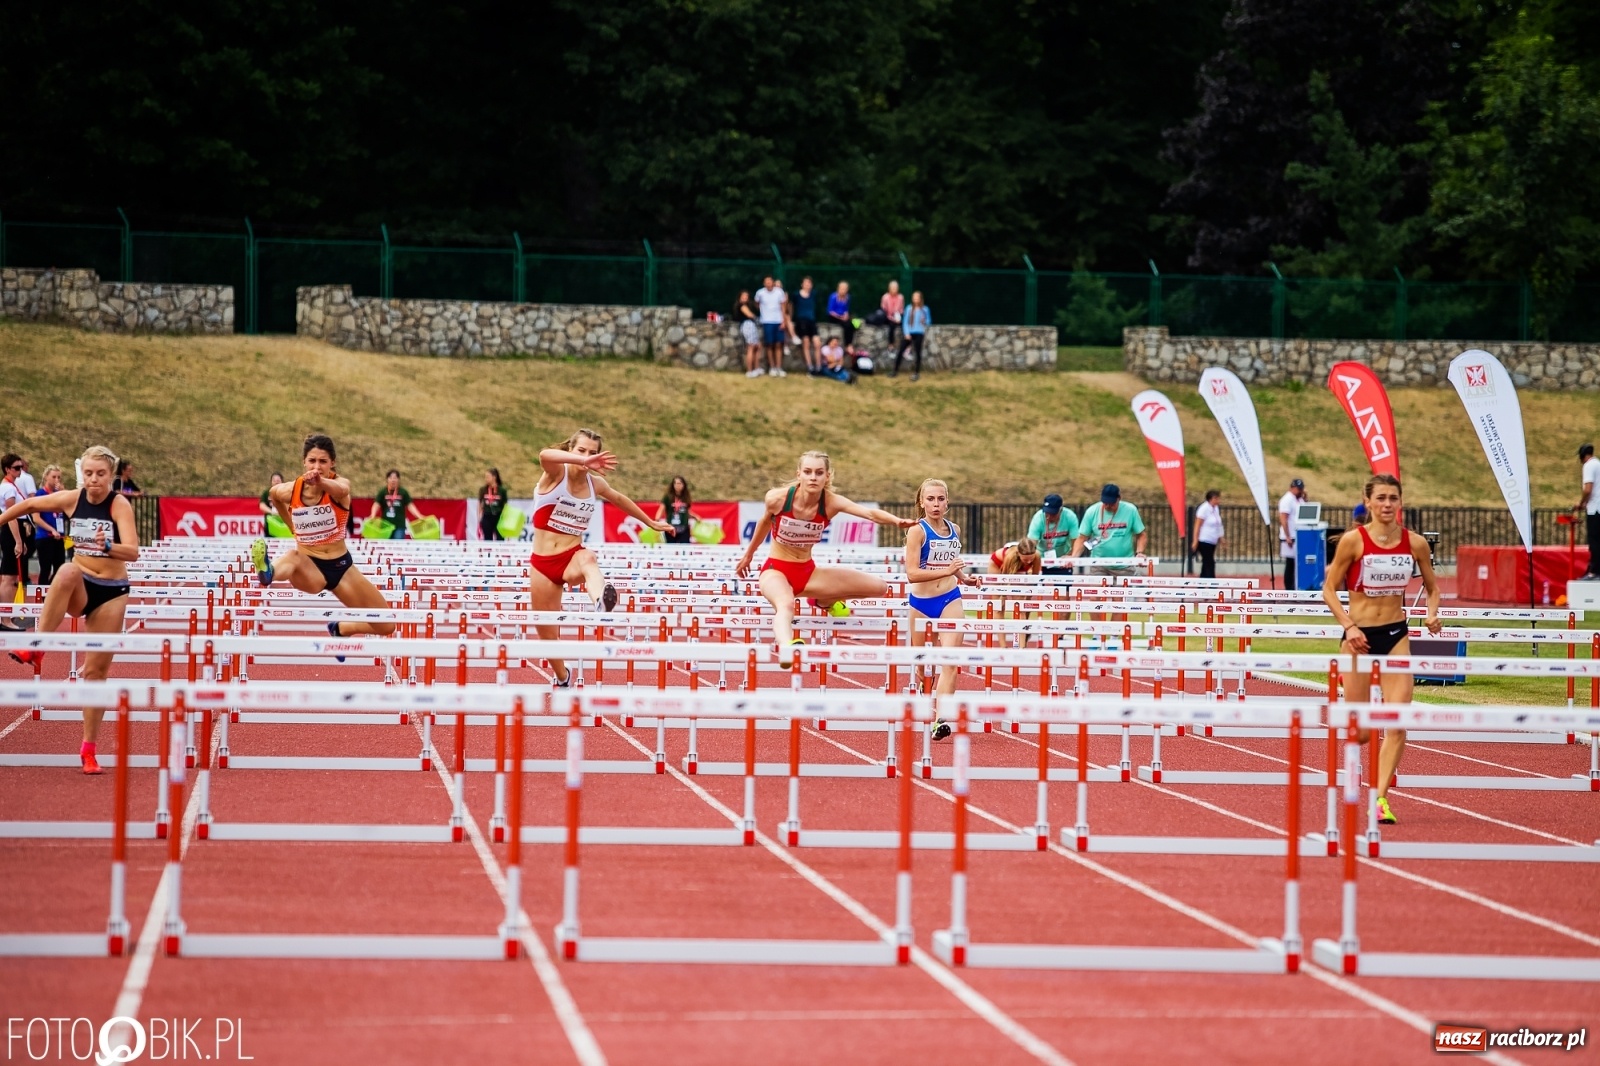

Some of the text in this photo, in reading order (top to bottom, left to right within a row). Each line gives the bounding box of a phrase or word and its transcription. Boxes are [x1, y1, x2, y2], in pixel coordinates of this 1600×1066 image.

[313, 506, 332, 516] 300
[579, 502, 595, 512] 273
[804, 522, 823, 531] 410
[933, 551, 956, 561] KŁOS
[1391, 556, 1411, 567] 524
[1370, 573, 1406, 582] KIEPURA
[323, 643, 365, 653] polanik
